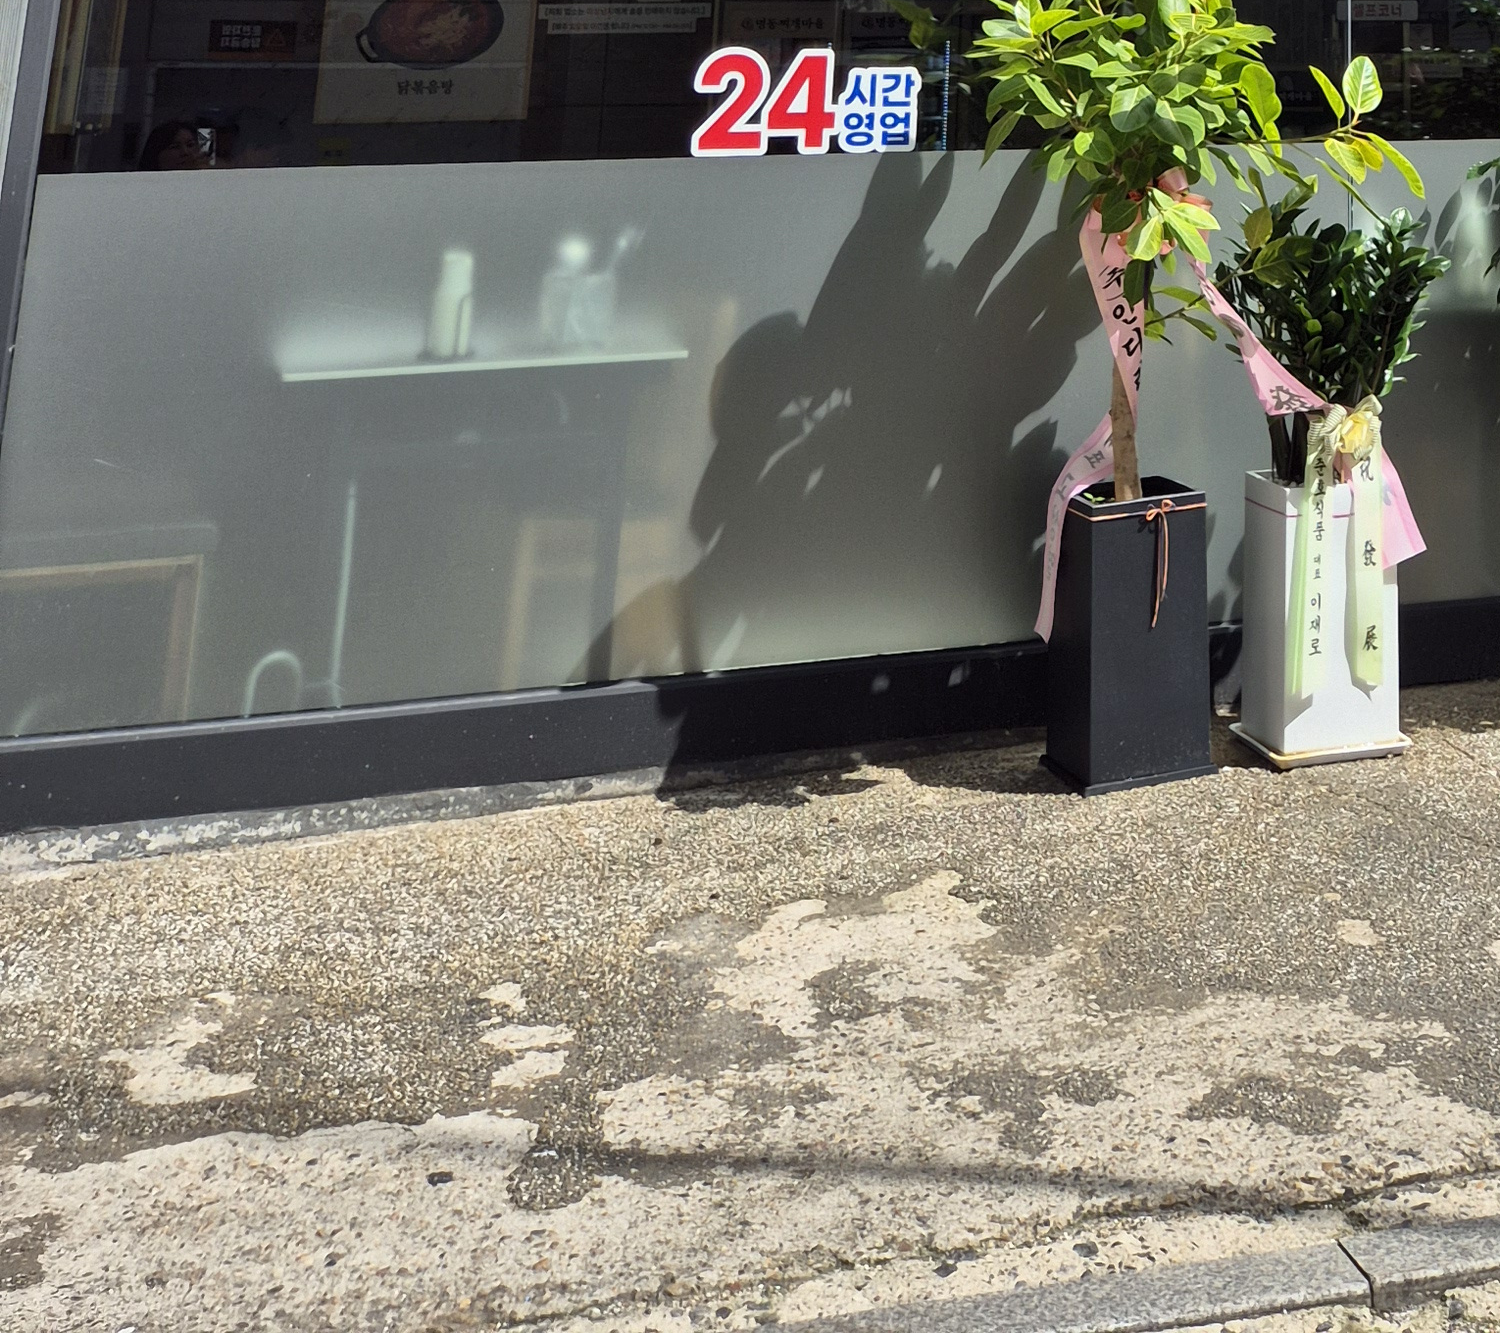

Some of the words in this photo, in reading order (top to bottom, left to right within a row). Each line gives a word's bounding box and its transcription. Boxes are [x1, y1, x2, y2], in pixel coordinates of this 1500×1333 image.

[1352, 3, 1402, 18] 셀프코너
[397, 78, 454, 96] 닭볶음탕
[697, 53, 836, 151] 24
[844, 73, 916, 108] 시간
[843, 111, 911, 146] 영업
